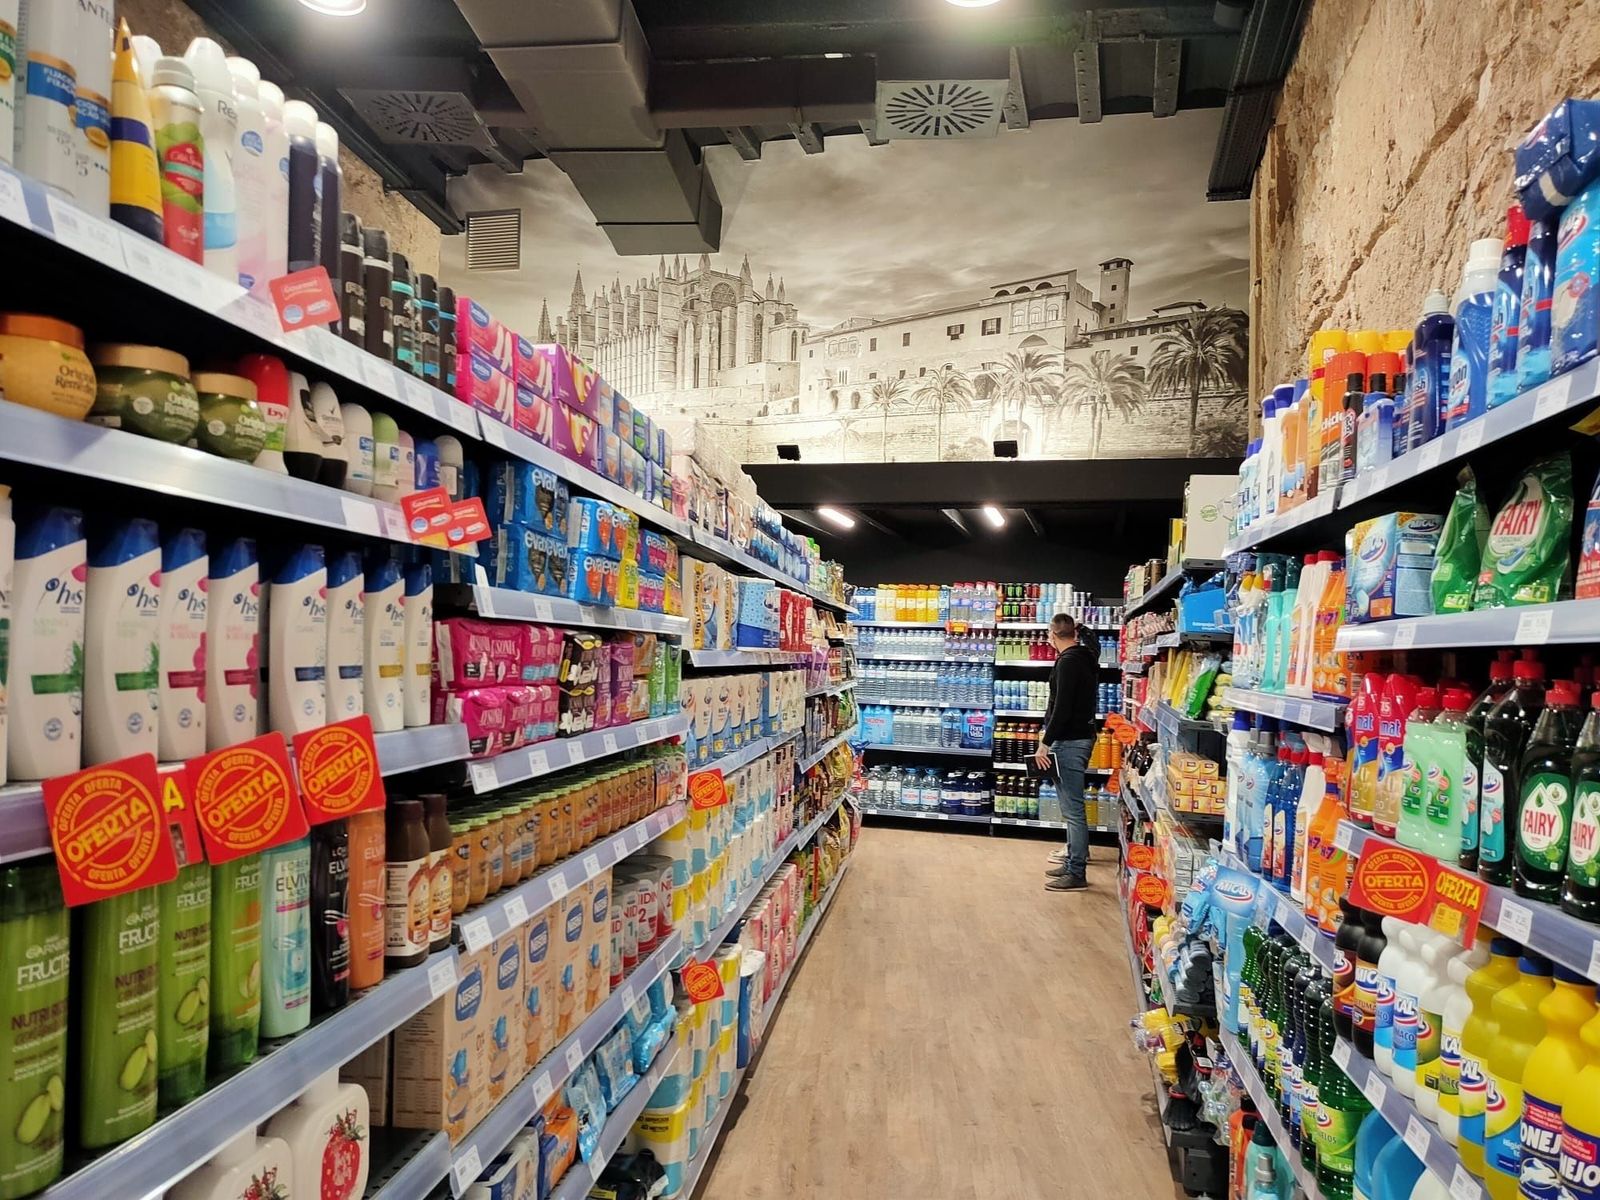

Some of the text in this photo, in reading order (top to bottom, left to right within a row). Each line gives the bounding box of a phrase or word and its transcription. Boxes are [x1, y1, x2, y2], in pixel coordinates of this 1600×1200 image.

[1493, 499, 1542, 536] FAIRY
[84, 777, 122, 794] OFERTA
[307, 746, 367, 794] OFERTA
[58, 792, 83, 832] OFERTA
[207, 769, 281, 828] OFERTA
[65, 796, 150, 863] OFERTA
[1522, 809, 1557, 838] FAIRY
[128, 831, 154, 870] OFERTA
[87, 867, 127, 882] OFERTA
[1363, 873, 1425, 889] OFERTA
[1435, 870, 1482, 911] OFERTA
[627, 922, 634, 937] 1
[638, 907, 647, 923] 2
[1520, 1119, 1562, 1154] ONEJ
